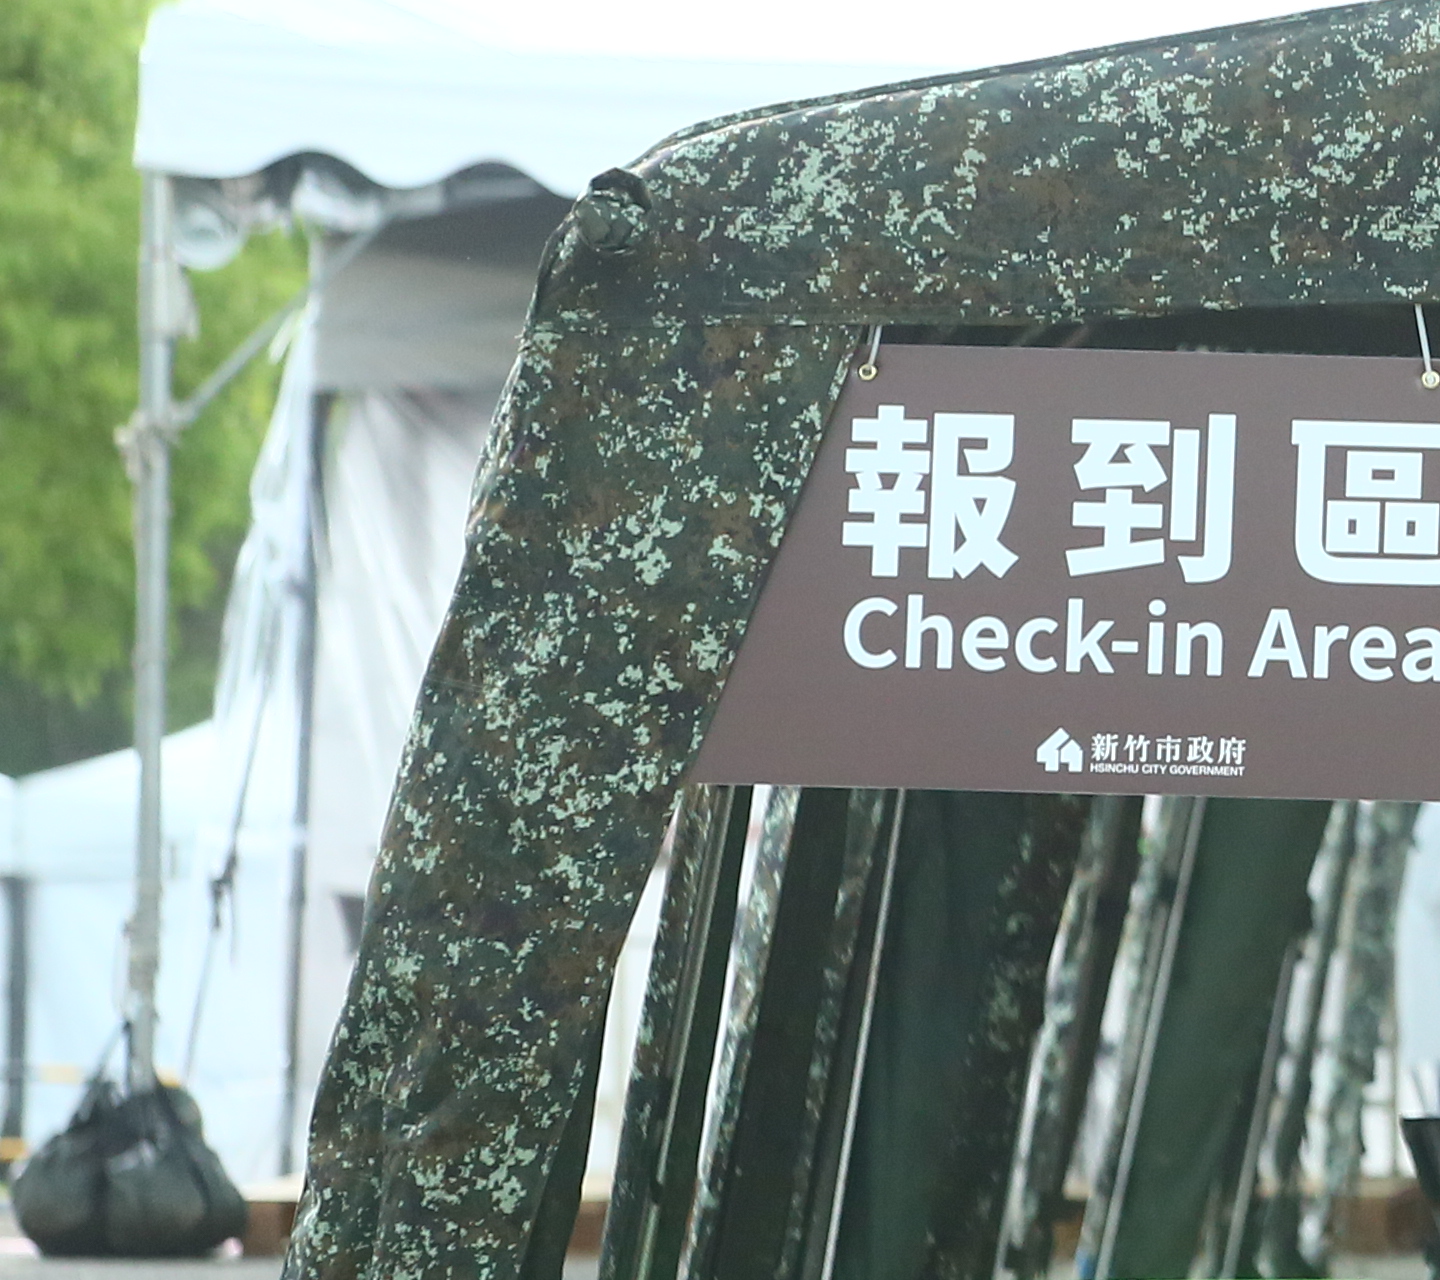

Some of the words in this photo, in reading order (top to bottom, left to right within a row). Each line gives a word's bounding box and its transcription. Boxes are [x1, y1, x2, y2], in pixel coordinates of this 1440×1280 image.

[843, 594, 1223, 677] Check-in
[1090, 733, 1247, 765] 新竹市政府
[1090, 763, 1139, 775] HSINCHU
[1142, 764, 1167, 775] CITY
[1169, 764, 1245, 777] GOVERNMENT
